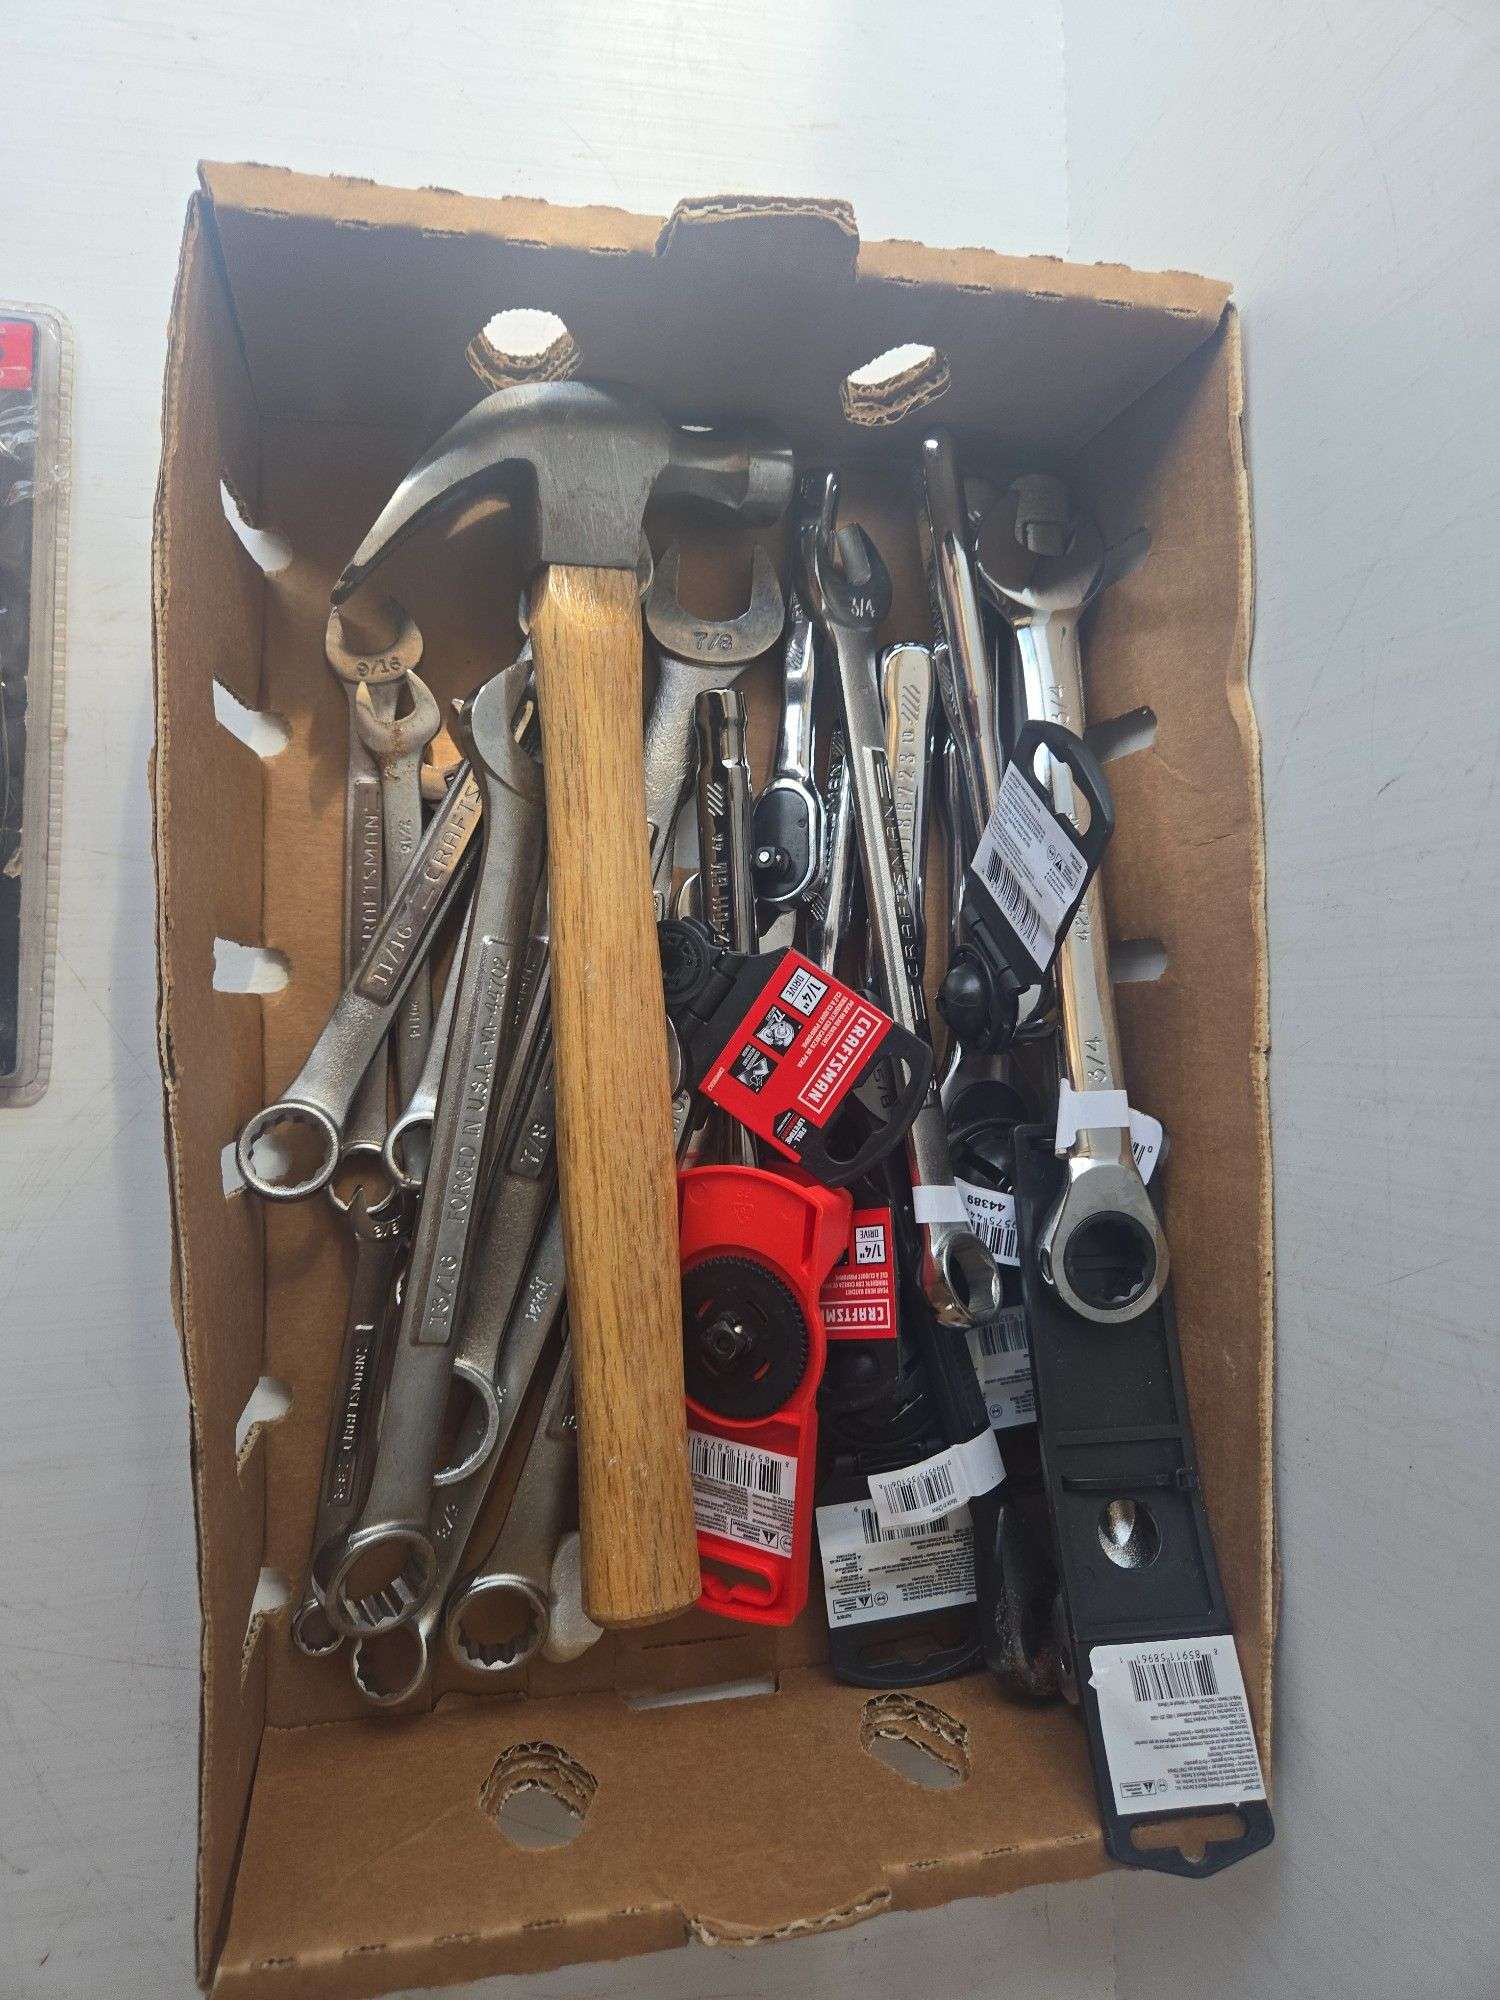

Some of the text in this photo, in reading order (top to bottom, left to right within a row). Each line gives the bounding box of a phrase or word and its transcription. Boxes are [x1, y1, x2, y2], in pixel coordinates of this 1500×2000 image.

[693, 630, 733, 651] 7/8
[360, 814, 380, 942] RAFTSMAN
[370, 785, 481, 986] 11/16 CRAFTS
[883, 804, 919, 977] CRAFTSMAN
[785, 974, 804, 997] DRIVE
[795, 980, 822, 1010] 1/4"
[806, 1015, 872, 1104] CRAFTSMAN
[1084, 1035, 1108, 1083] 3/4
[442, 1143, 481, 1225] FORGED
[966, 1193, 1006, 1212] 44389
[859, 1229, 878, 1238] DRIVE
[859, 1243, 881, 1258] 1/4"
[824, 1307, 883, 1321] CRAFTSM
[1135, 1651, 1165, 1664] 58961
[1169, 1648, 1200, 1661] 85911
